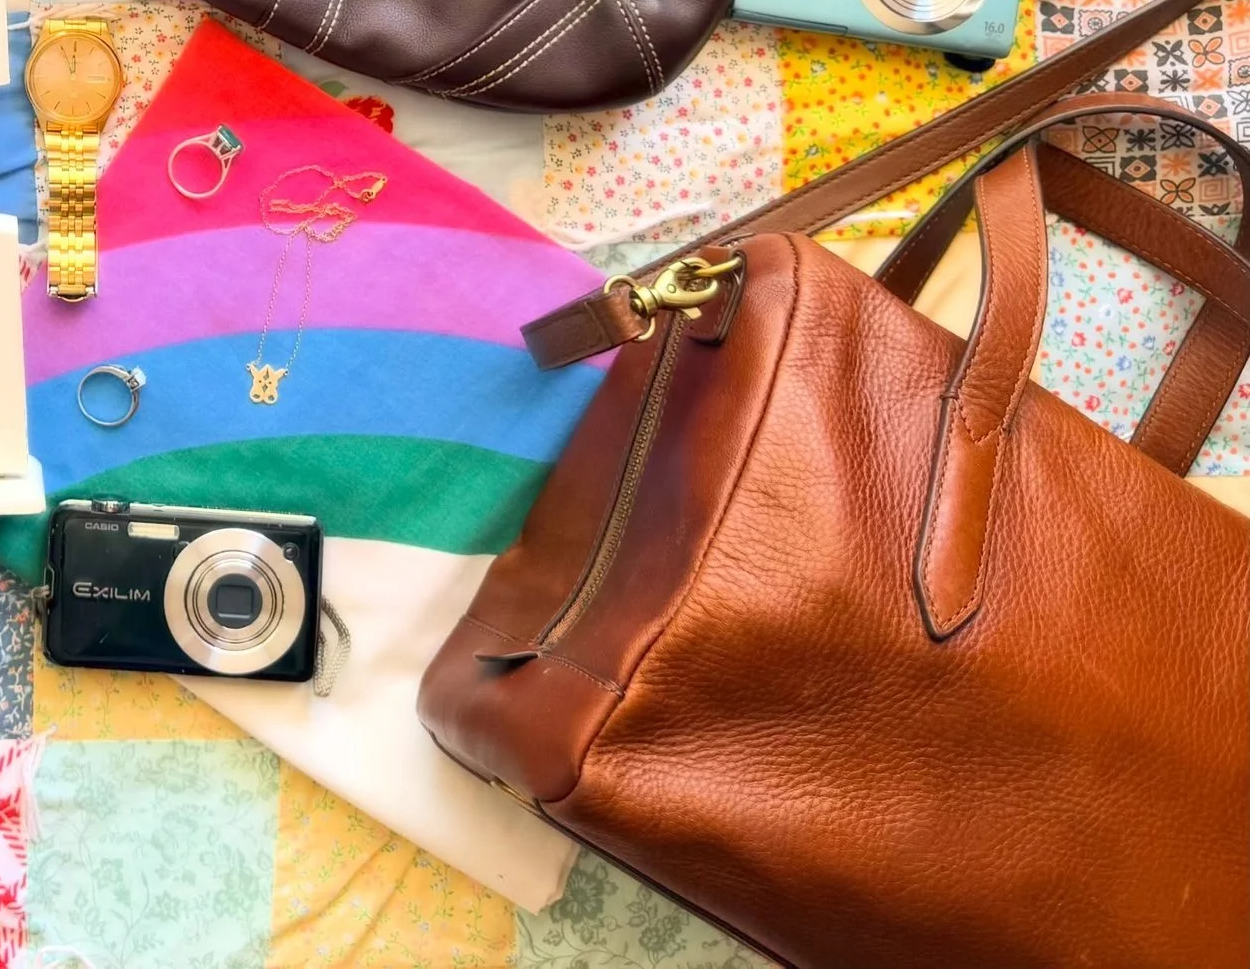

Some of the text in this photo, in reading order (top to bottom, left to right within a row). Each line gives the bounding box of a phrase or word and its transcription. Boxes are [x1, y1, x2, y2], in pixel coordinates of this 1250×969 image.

[984, 21, 1005, 34] 16.0
[84, 521, 119, 532] CASIO
[72, 582, 151, 602] EXILIM
